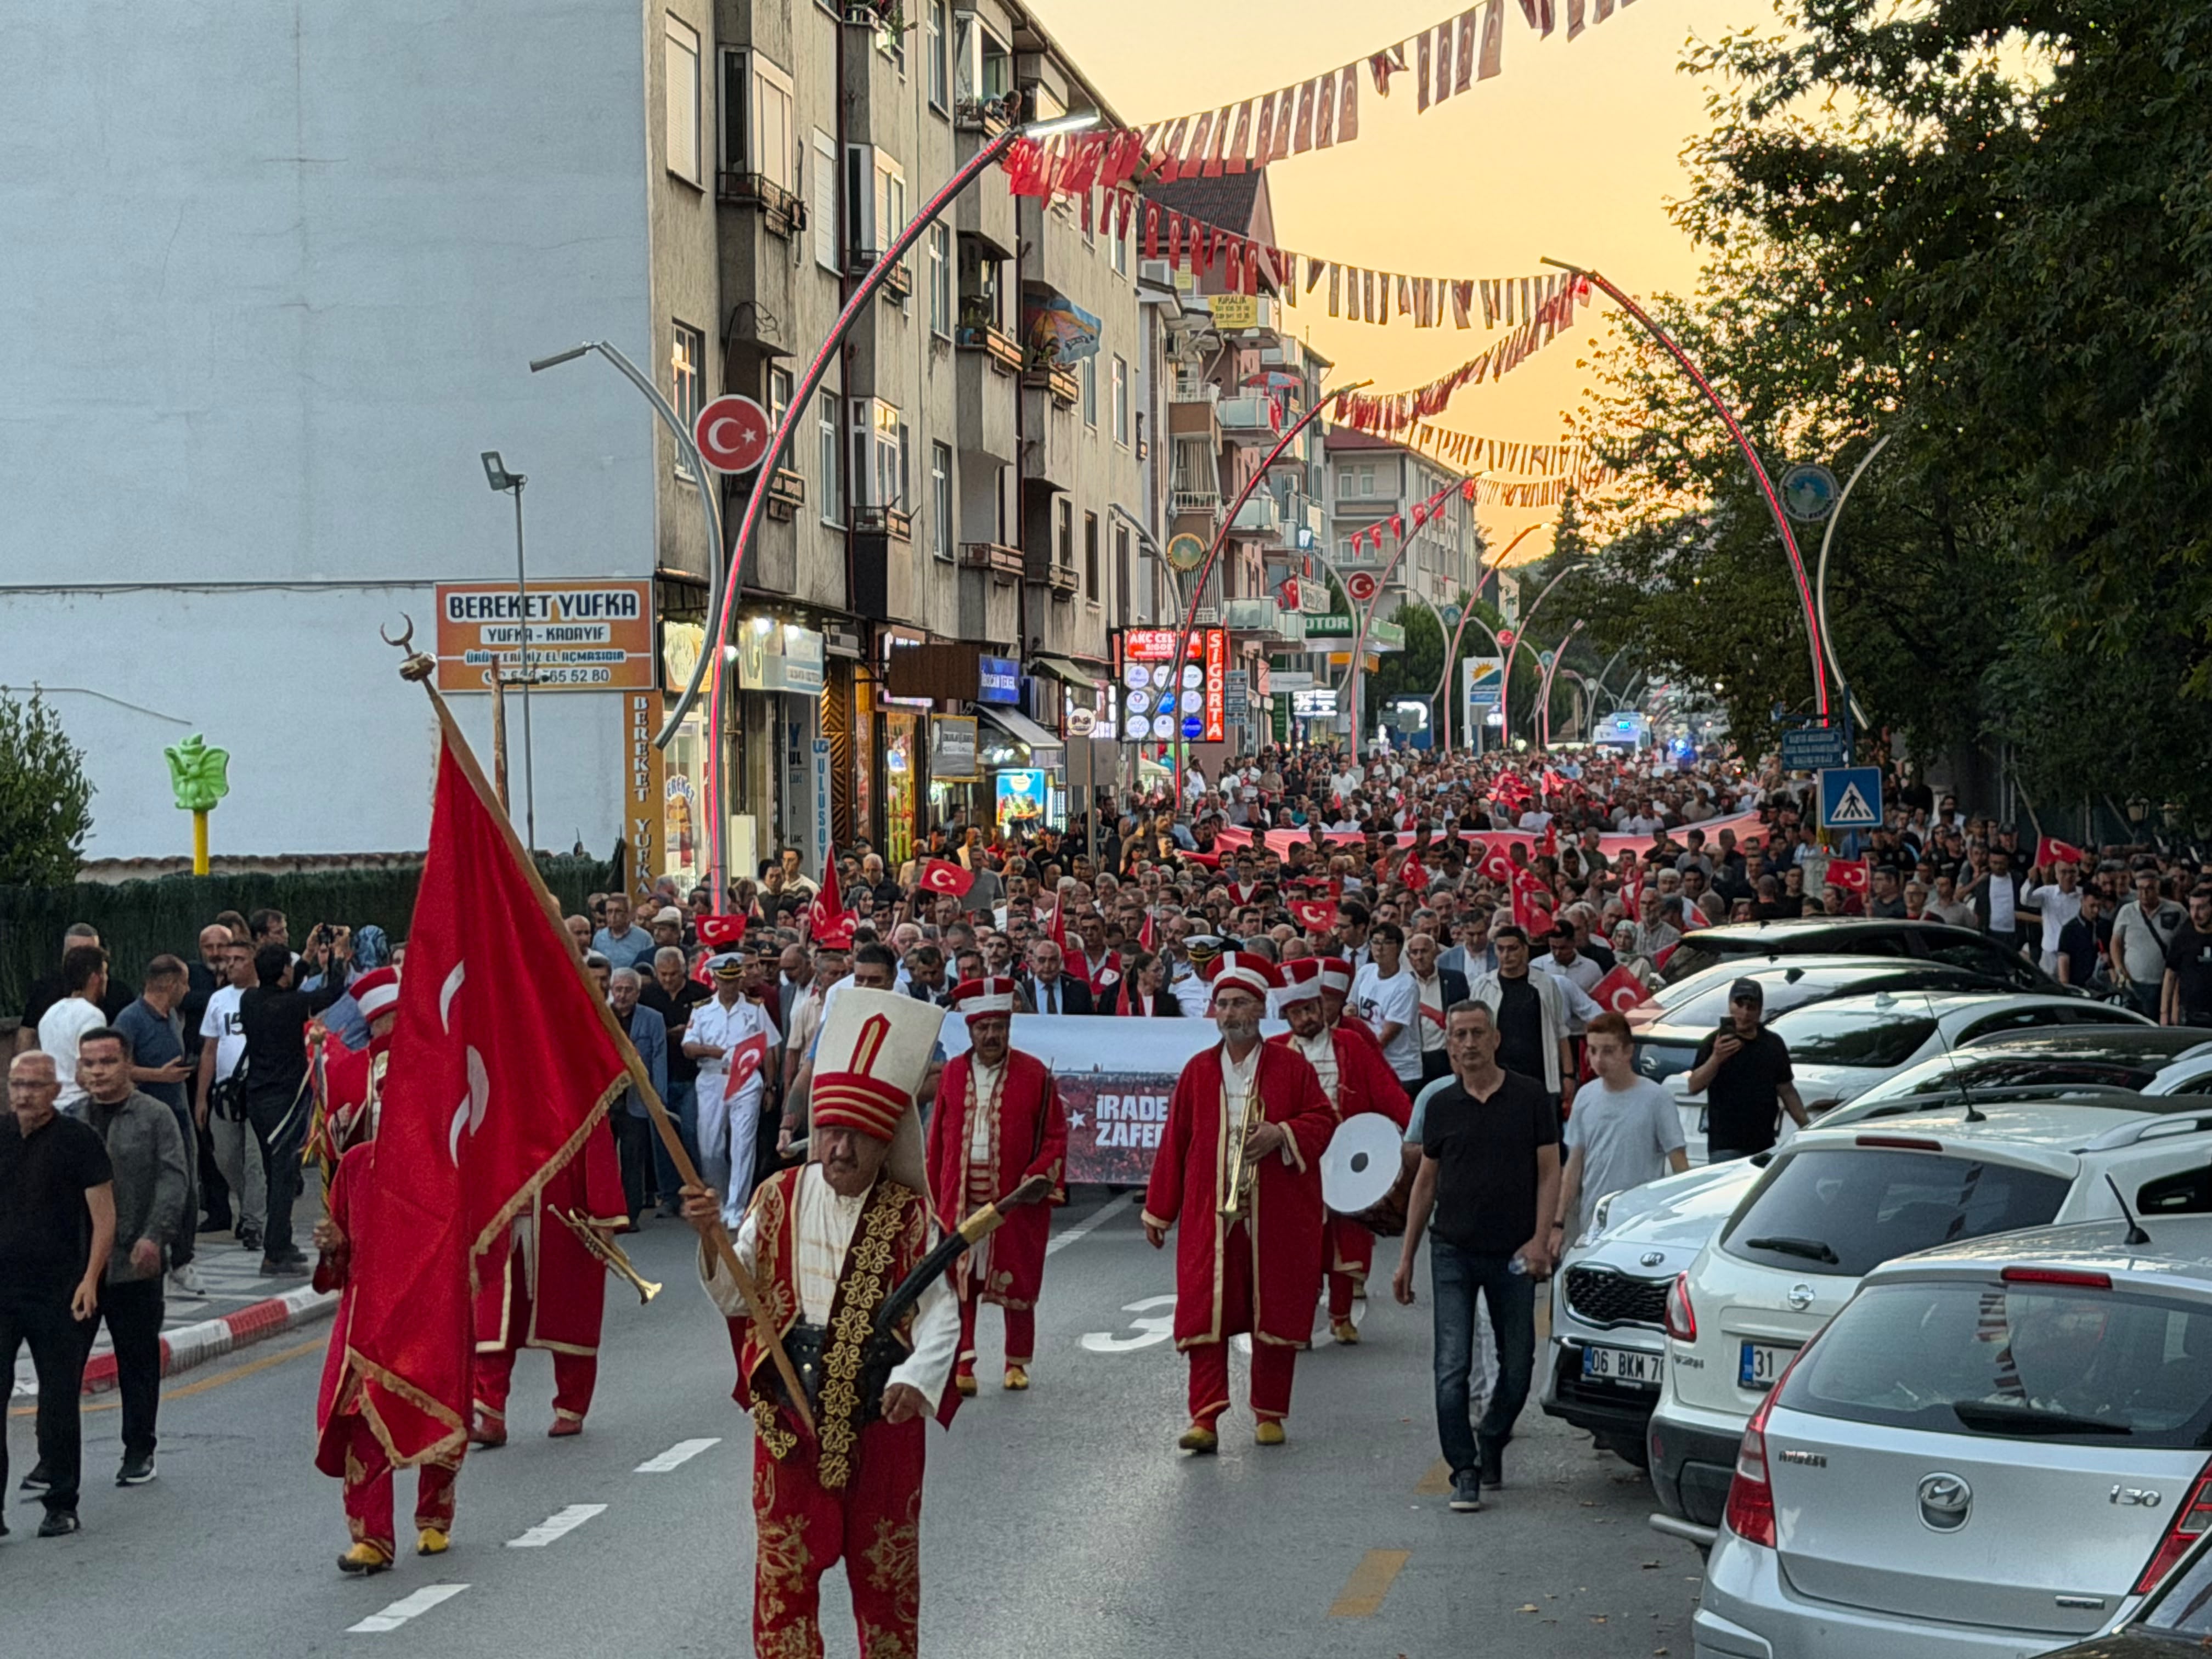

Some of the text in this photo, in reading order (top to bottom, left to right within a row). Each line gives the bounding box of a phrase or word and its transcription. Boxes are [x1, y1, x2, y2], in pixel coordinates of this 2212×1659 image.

[449, 593, 637, 619] BEREKET YUFKA
[487, 628, 533, 642] YUFKA
[546, 626, 605, 641] KADAYIF
[1305, 616, 1350, 630] OTOR
[571, 669, 588, 682] 52
[592, 669, 609, 682] 80
[633, 696, 650, 802] BEREKET
[817, 758, 826, 861] ULUSOY
[634, 818, 652, 894] YUFKA
[1593, 1350, 1609, 1373] 06
[1618, 1352, 1645, 1379] BKM
[1754, 1350, 1773, 1378] 31
